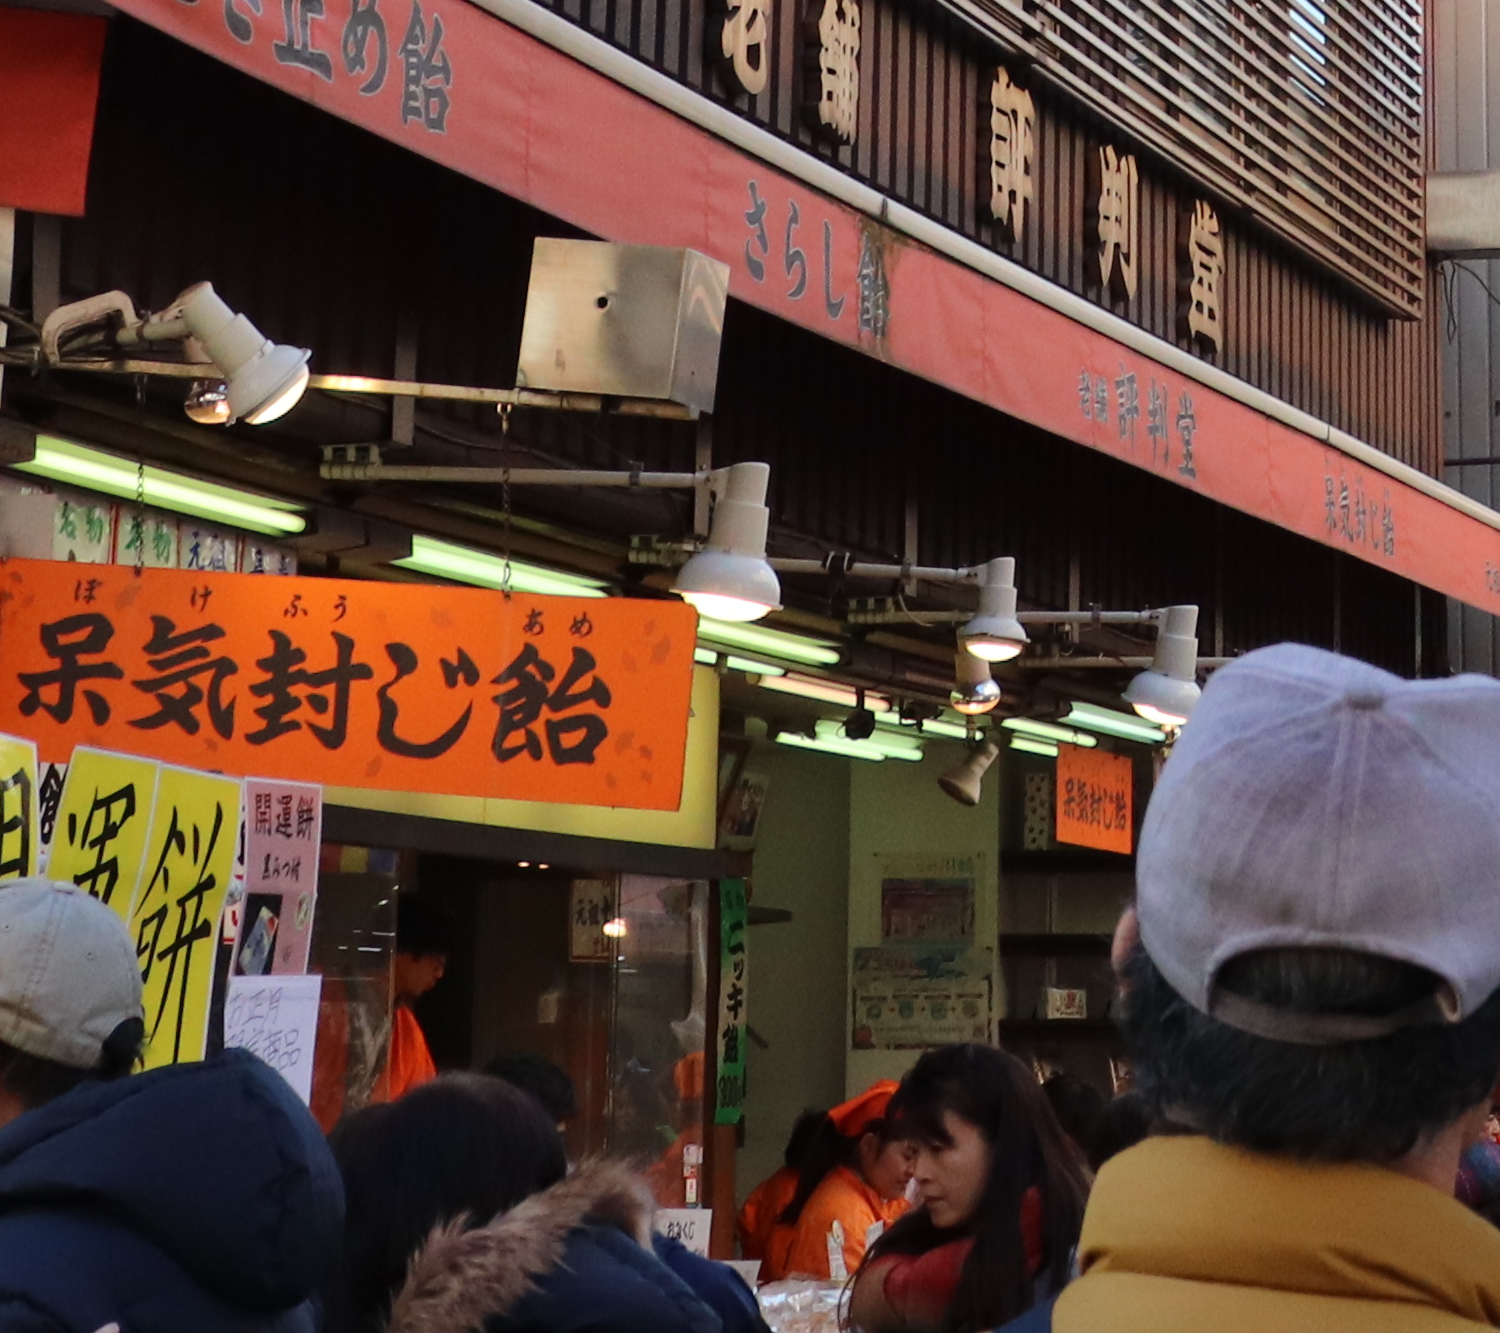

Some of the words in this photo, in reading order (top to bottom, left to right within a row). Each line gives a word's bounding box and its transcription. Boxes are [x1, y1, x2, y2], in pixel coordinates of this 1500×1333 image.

[743, 180, 891, 339] さらし飴
[988, 65, 1224, 355] 評判堂
[1113, 360, 1197, 481] 評判堂
[1323, 474, 1396, 558] 呆気封じ飴
[17, 610, 613, 766] 呆気封じ飴
